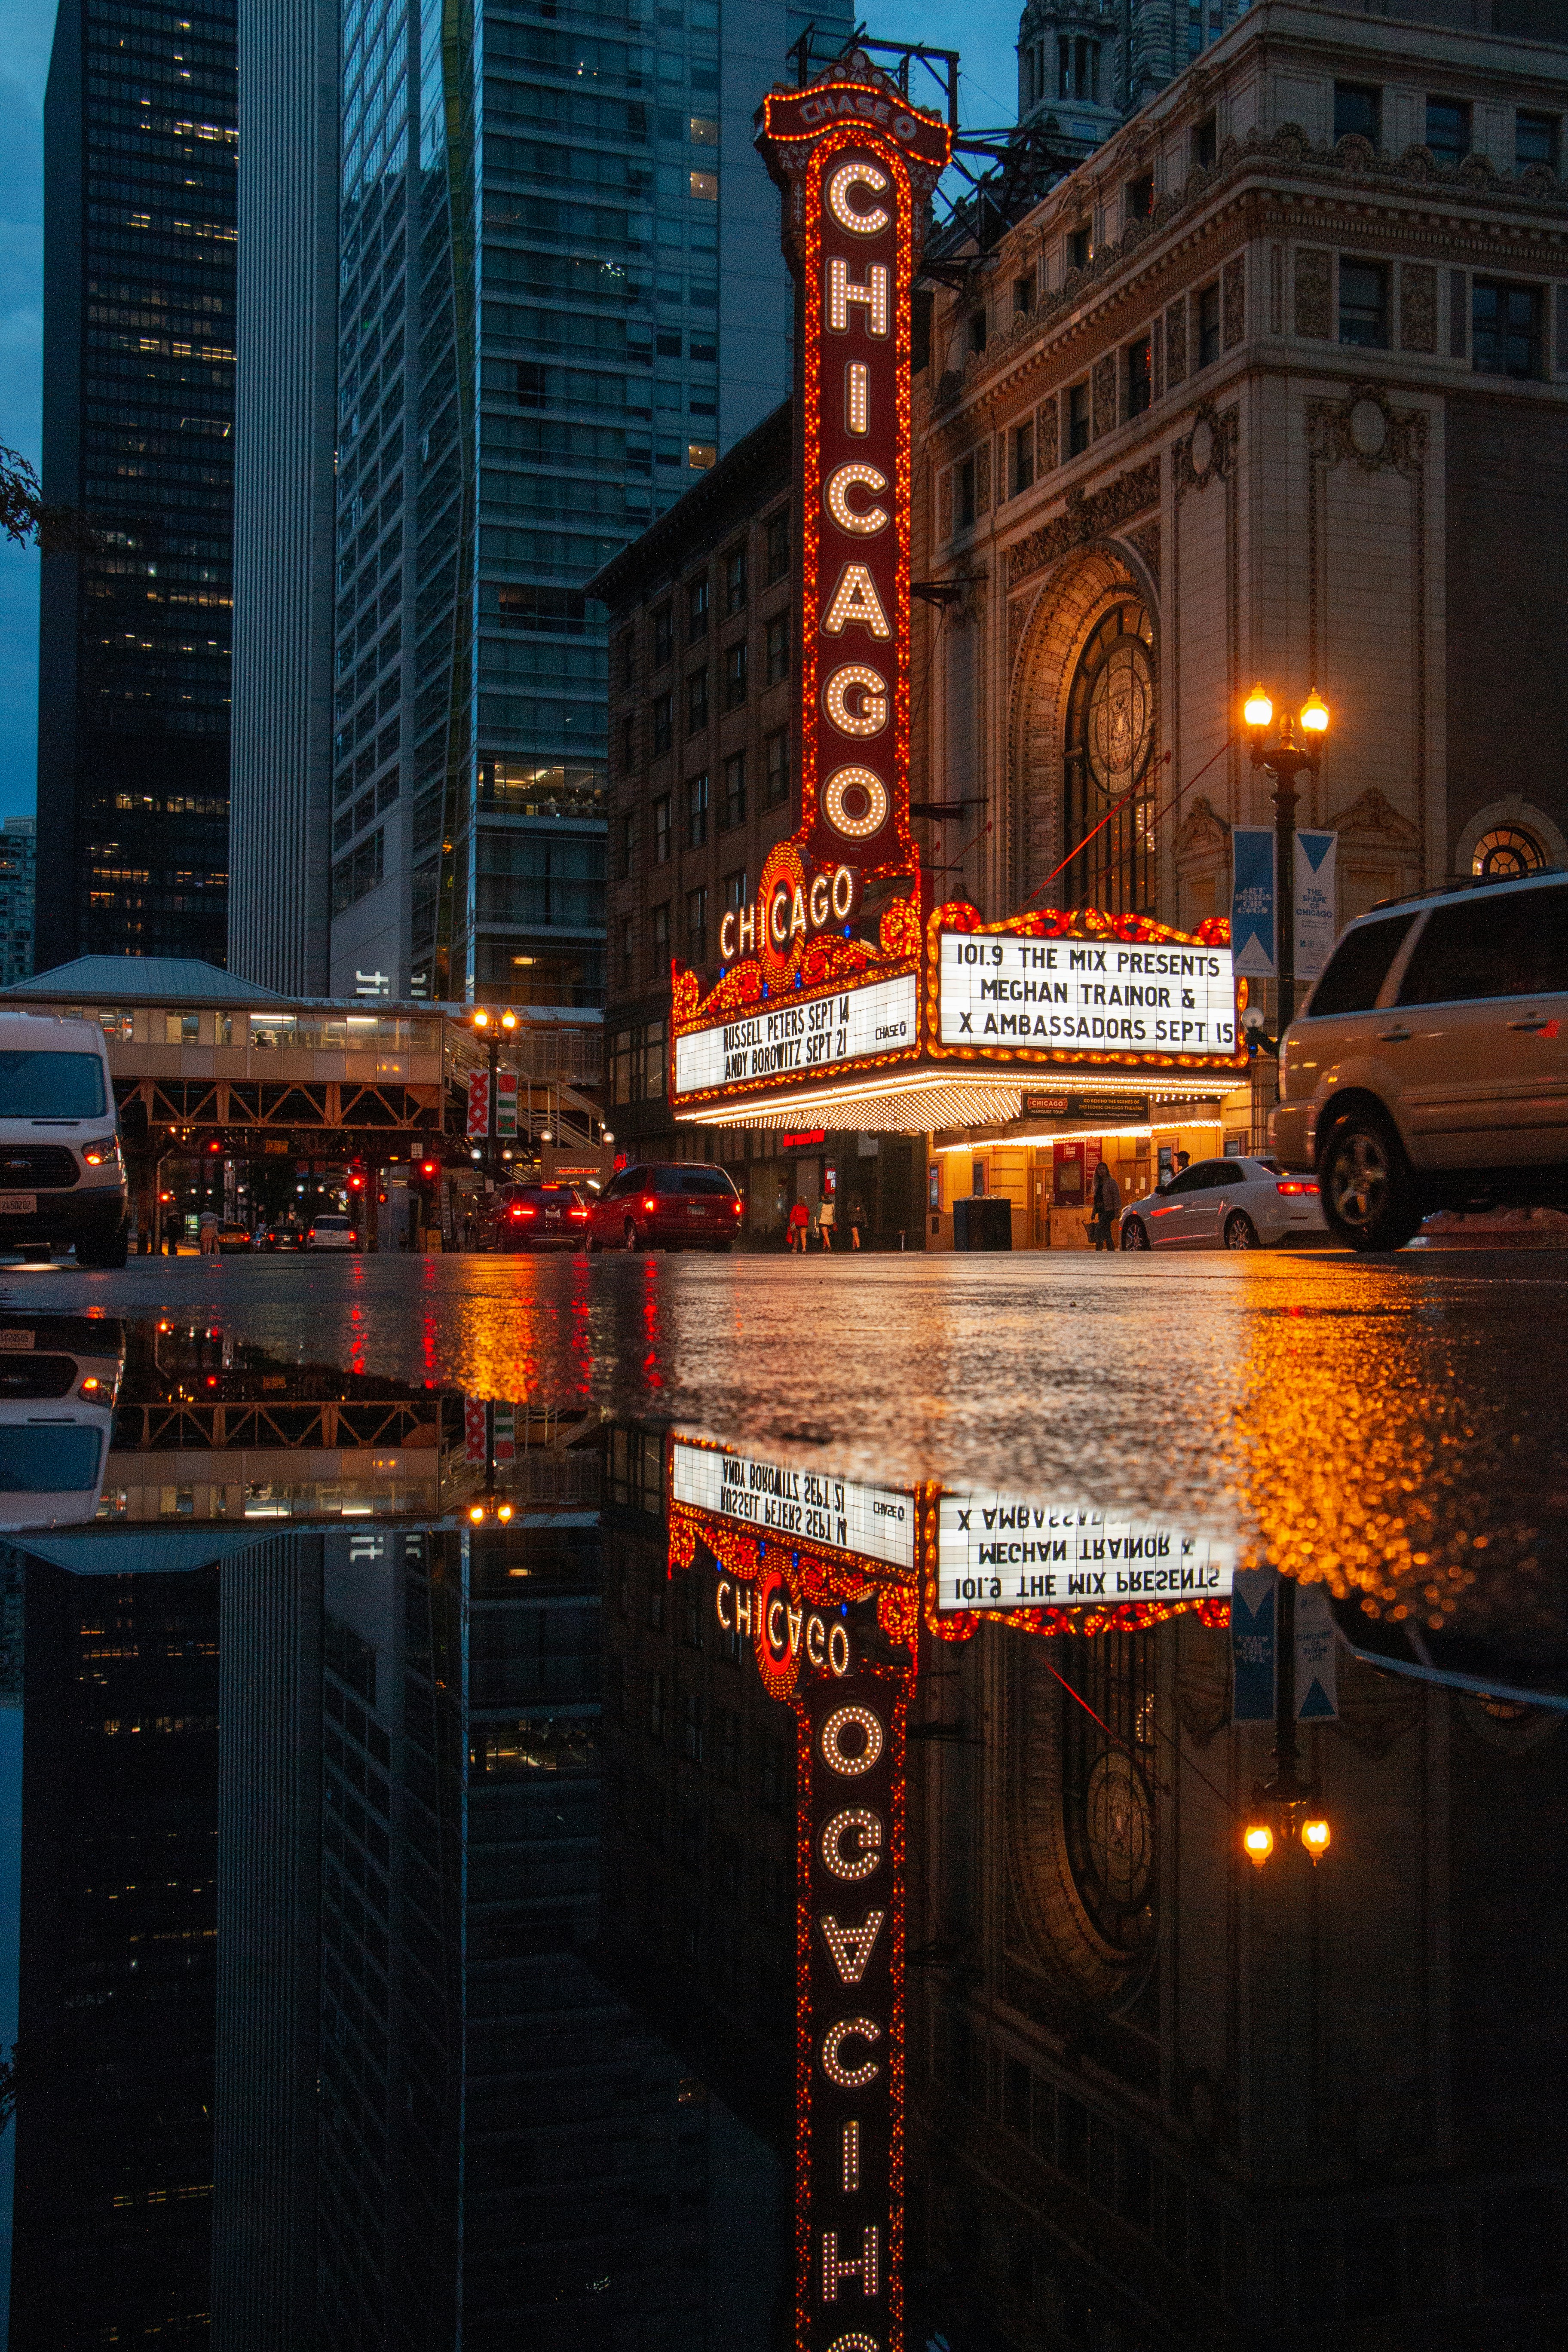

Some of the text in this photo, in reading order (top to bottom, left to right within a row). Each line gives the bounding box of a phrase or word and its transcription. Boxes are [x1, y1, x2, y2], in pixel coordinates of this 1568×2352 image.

[800, 95, 891, 124] CHASE
[825, 164, 889, 836] CHICAGO
[720, 866, 853, 959] CHICAGO
[1296, 909, 1332, 918] CHICAGO
[958, 943, 1220, 977] 101.9 THE MIX PRESENTS
[981, 979, 1195, 1009] MEGHAN TRAINOR &
[723, 995, 849, 1052] RUSSELL PETERS SEPT 14
[876, 1024, 899, 1040] CHASE
[959, 1012, 1233, 1044] X AMBASSADORS SEPT 15
[725, 1028, 846, 1080] ANDY BOROWITZ SEPT 21
